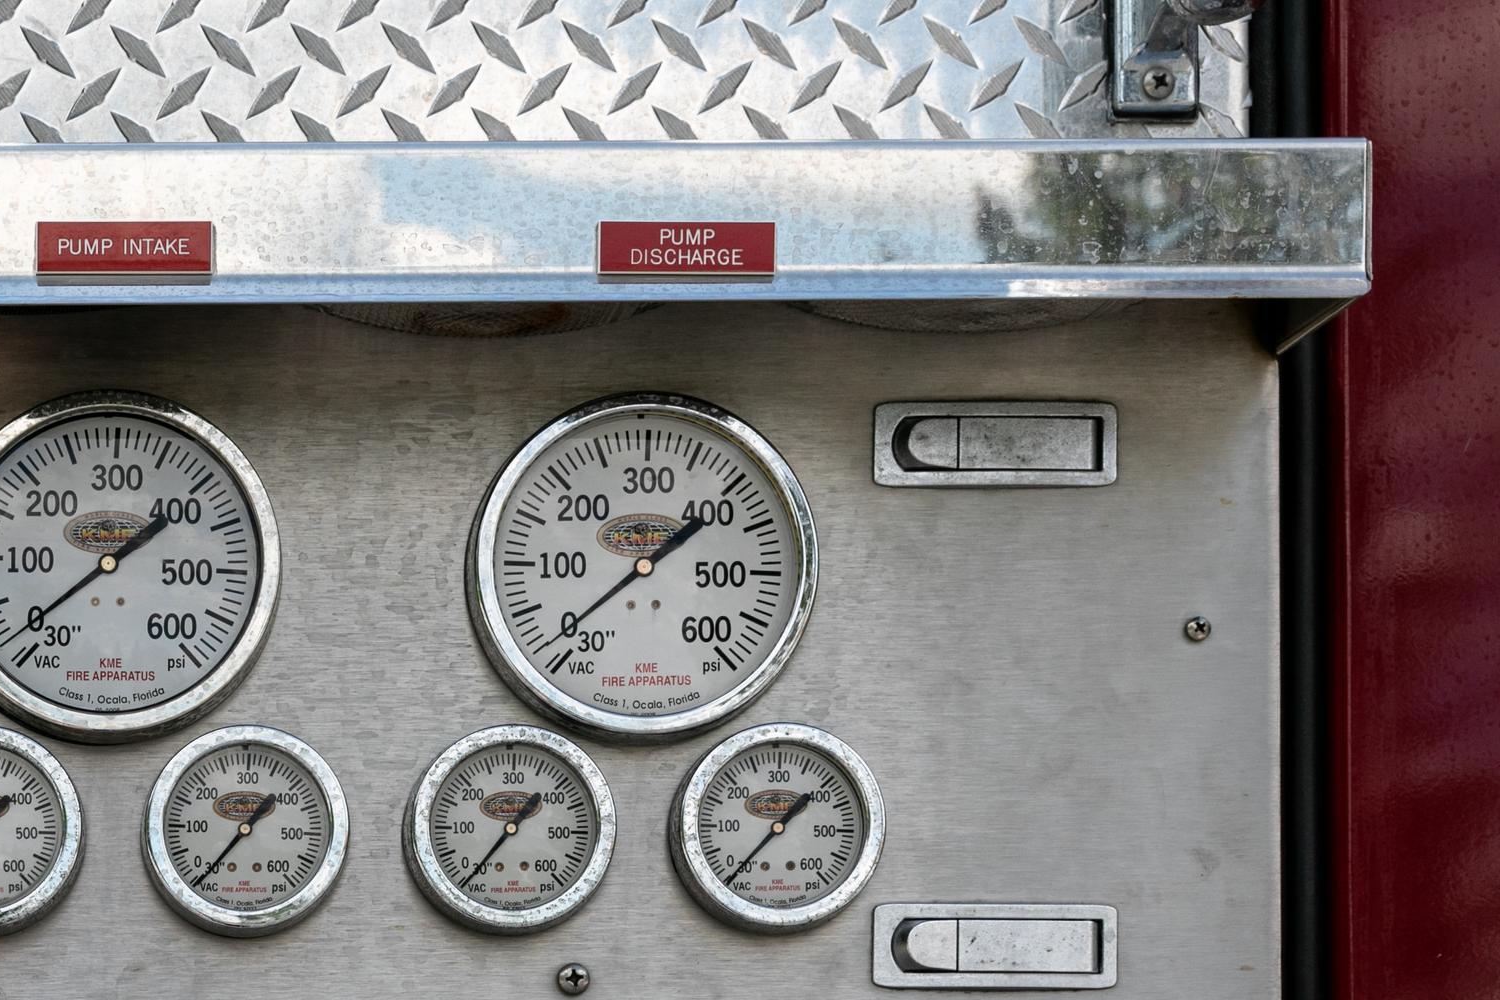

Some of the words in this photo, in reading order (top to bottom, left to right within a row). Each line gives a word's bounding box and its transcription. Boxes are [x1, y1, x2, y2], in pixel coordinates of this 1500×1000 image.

[660, 228, 715, 245] PUMP
[58, 239, 113, 256] PUMP
[123, 238, 190, 255] INTAKE
[631, 248, 743, 266] DISCHARGE
[90, 464, 143, 491] 300
[622, 466, 675, 494] 300
[25, 490, 78, 517] 200
[149, 498, 201, 525] 400
[557, 494, 610, 521] 200
[681, 499, 734, 526] 400
[7, 546, 54, 573] 100
[540, 551, 586, 579] 100
[161, 558, 213, 585] 500
[695, 560, 746, 588] 500
[27, 605, 45, 632] 0
[147, 612, 197, 640] 600
[560, 611, 578, 638] 0
[681, 615, 732, 643] 600
[33, 655, 60, 669] VAC
[99, 658, 122, 668] KME
[167, 655, 185, 671] psi
[567, 661, 595, 675] VAC
[635, 663, 658, 673] KME
[702, 659, 721, 675] psi
[66, 671, 89, 681] FIRE
[92, 671, 155, 681] APPARATUS
[602, 676, 625, 687] FIRE
[628, 675, 691, 686] APPARATUS
[58, 687, 84, 701] Class
[97, 695, 131, 705] Ocala,
[132, 687, 165, 702] Florida
[593, 692, 618, 707] Class
[632, 700, 666, 709] Ocala,
[668, 691, 700, 707] Florida
[236, 772, 259, 784] 300
[502, 772, 524, 784] 300
[768, 770, 790, 783] 300
[16, 827, 38, 839] 500
[281, 827, 303, 840] 500
[548, 826, 570, 839] 500
[813, 825, 836, 837] 500
[540, 882, 555, 894] psi
